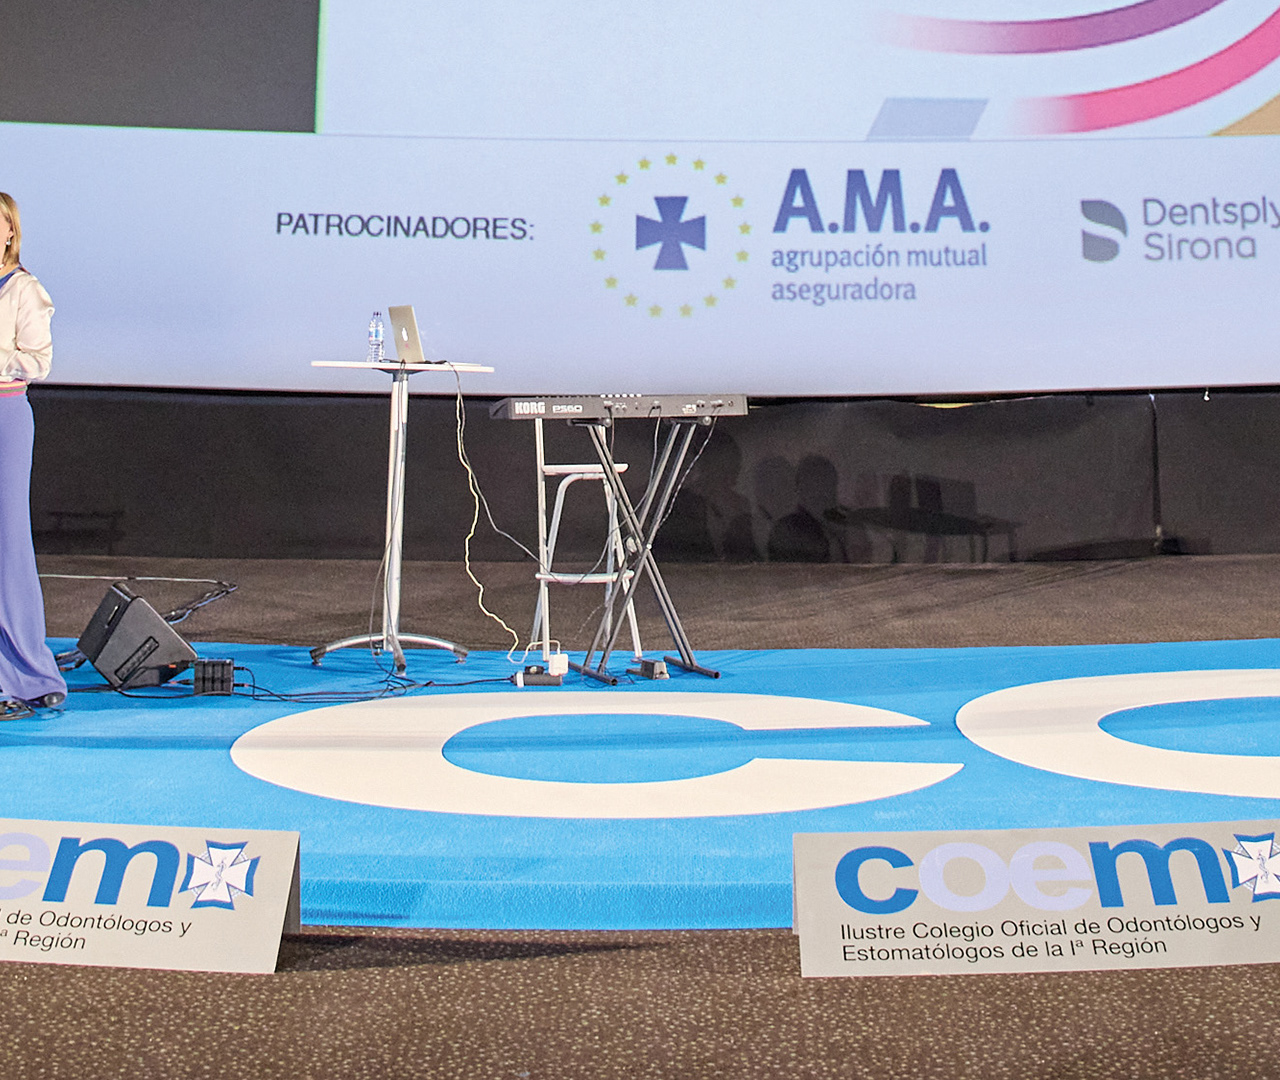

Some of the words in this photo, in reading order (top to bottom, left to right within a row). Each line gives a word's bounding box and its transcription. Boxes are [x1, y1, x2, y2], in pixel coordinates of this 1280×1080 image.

[772, 168, 991, 234] A.M.A.
[275, 212, 535, 241] PATROCINADORES:
[771, 243, 902, 273] agrupación
[906, 243, 988, 267] mutual
[1143, 232, 1257, 260] Sirona
[771, 277, 917, 306] aseguradora
[515, 401, 545, 414] KORG
[834, 836, 1231, 915] coem
[6, 909, 32, 925] de
[39, 910, 172, 936] Odontólogos
[179, 921, 192, 937] y
[841, 924, 905, 940] Ilustre
[912, 921, 994, 942] Colegio
[1001, 919, 1067, 936] Oficial
[1074, 918, 1101, 935] de
[1107, 915, 1245, 934] Odontólogos
[1249, 915, 1261, 931] y
[13, 930, 86, 952] Región
[843, 943, 1004, 963] Estomatólogos
[1012, 941, 1038, 958] de
[1045, 941, 1064, 957] la
[1092, 937, 1167, 958] Región
